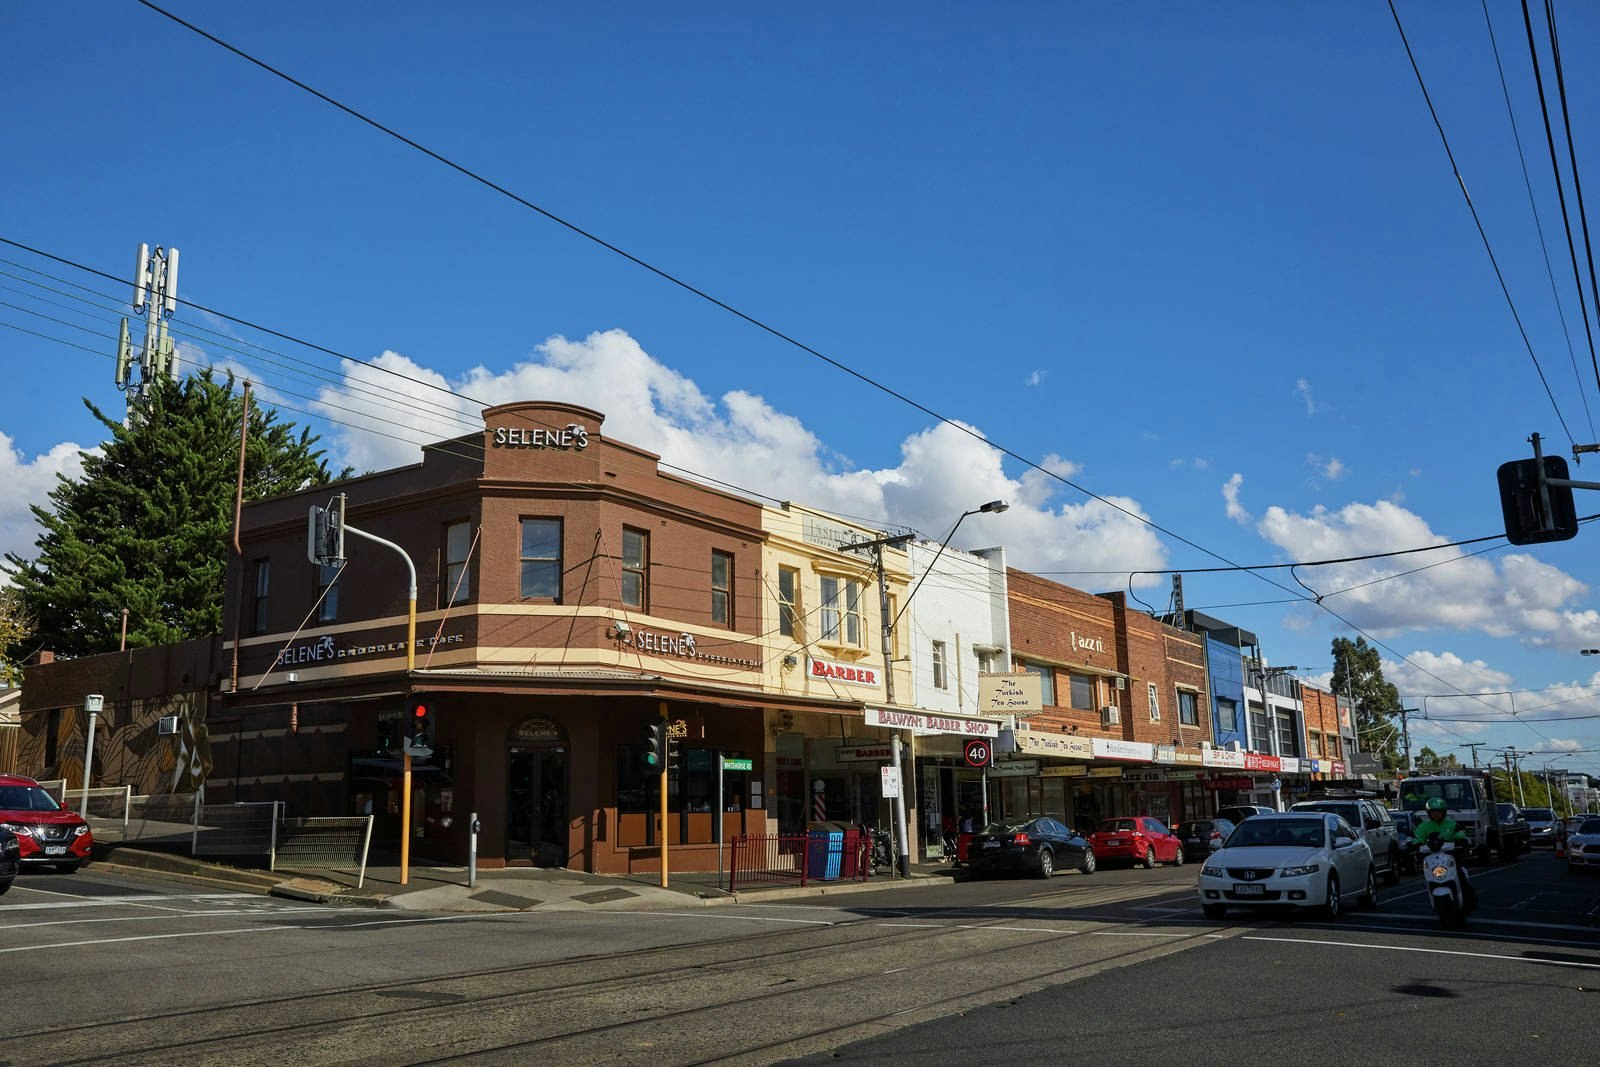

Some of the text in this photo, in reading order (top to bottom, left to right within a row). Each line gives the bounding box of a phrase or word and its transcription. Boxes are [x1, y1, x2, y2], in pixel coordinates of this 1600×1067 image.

[496, 426, 589, 448] SELENE'S
[278, 641, 335, 665] SELENE'S
[338, 639, 425, 658] CHOCOLAE
[638, 630, 696, 657] SELENE'S
[698, 651, 747, 665] CHOCOLATE
[812, 660, 876, 684] BARBER
[1001, 679, 1017, 688] The
[995, 689, 1024, 698] Turkish
[991, 698, 1029, 708] Tea House
[926, 715, 961, 732] BARBER
[964, 720, 989, 735] SHOP
[1029, 736, 1040, 749] The
[969, 747, 986, 759] 40
